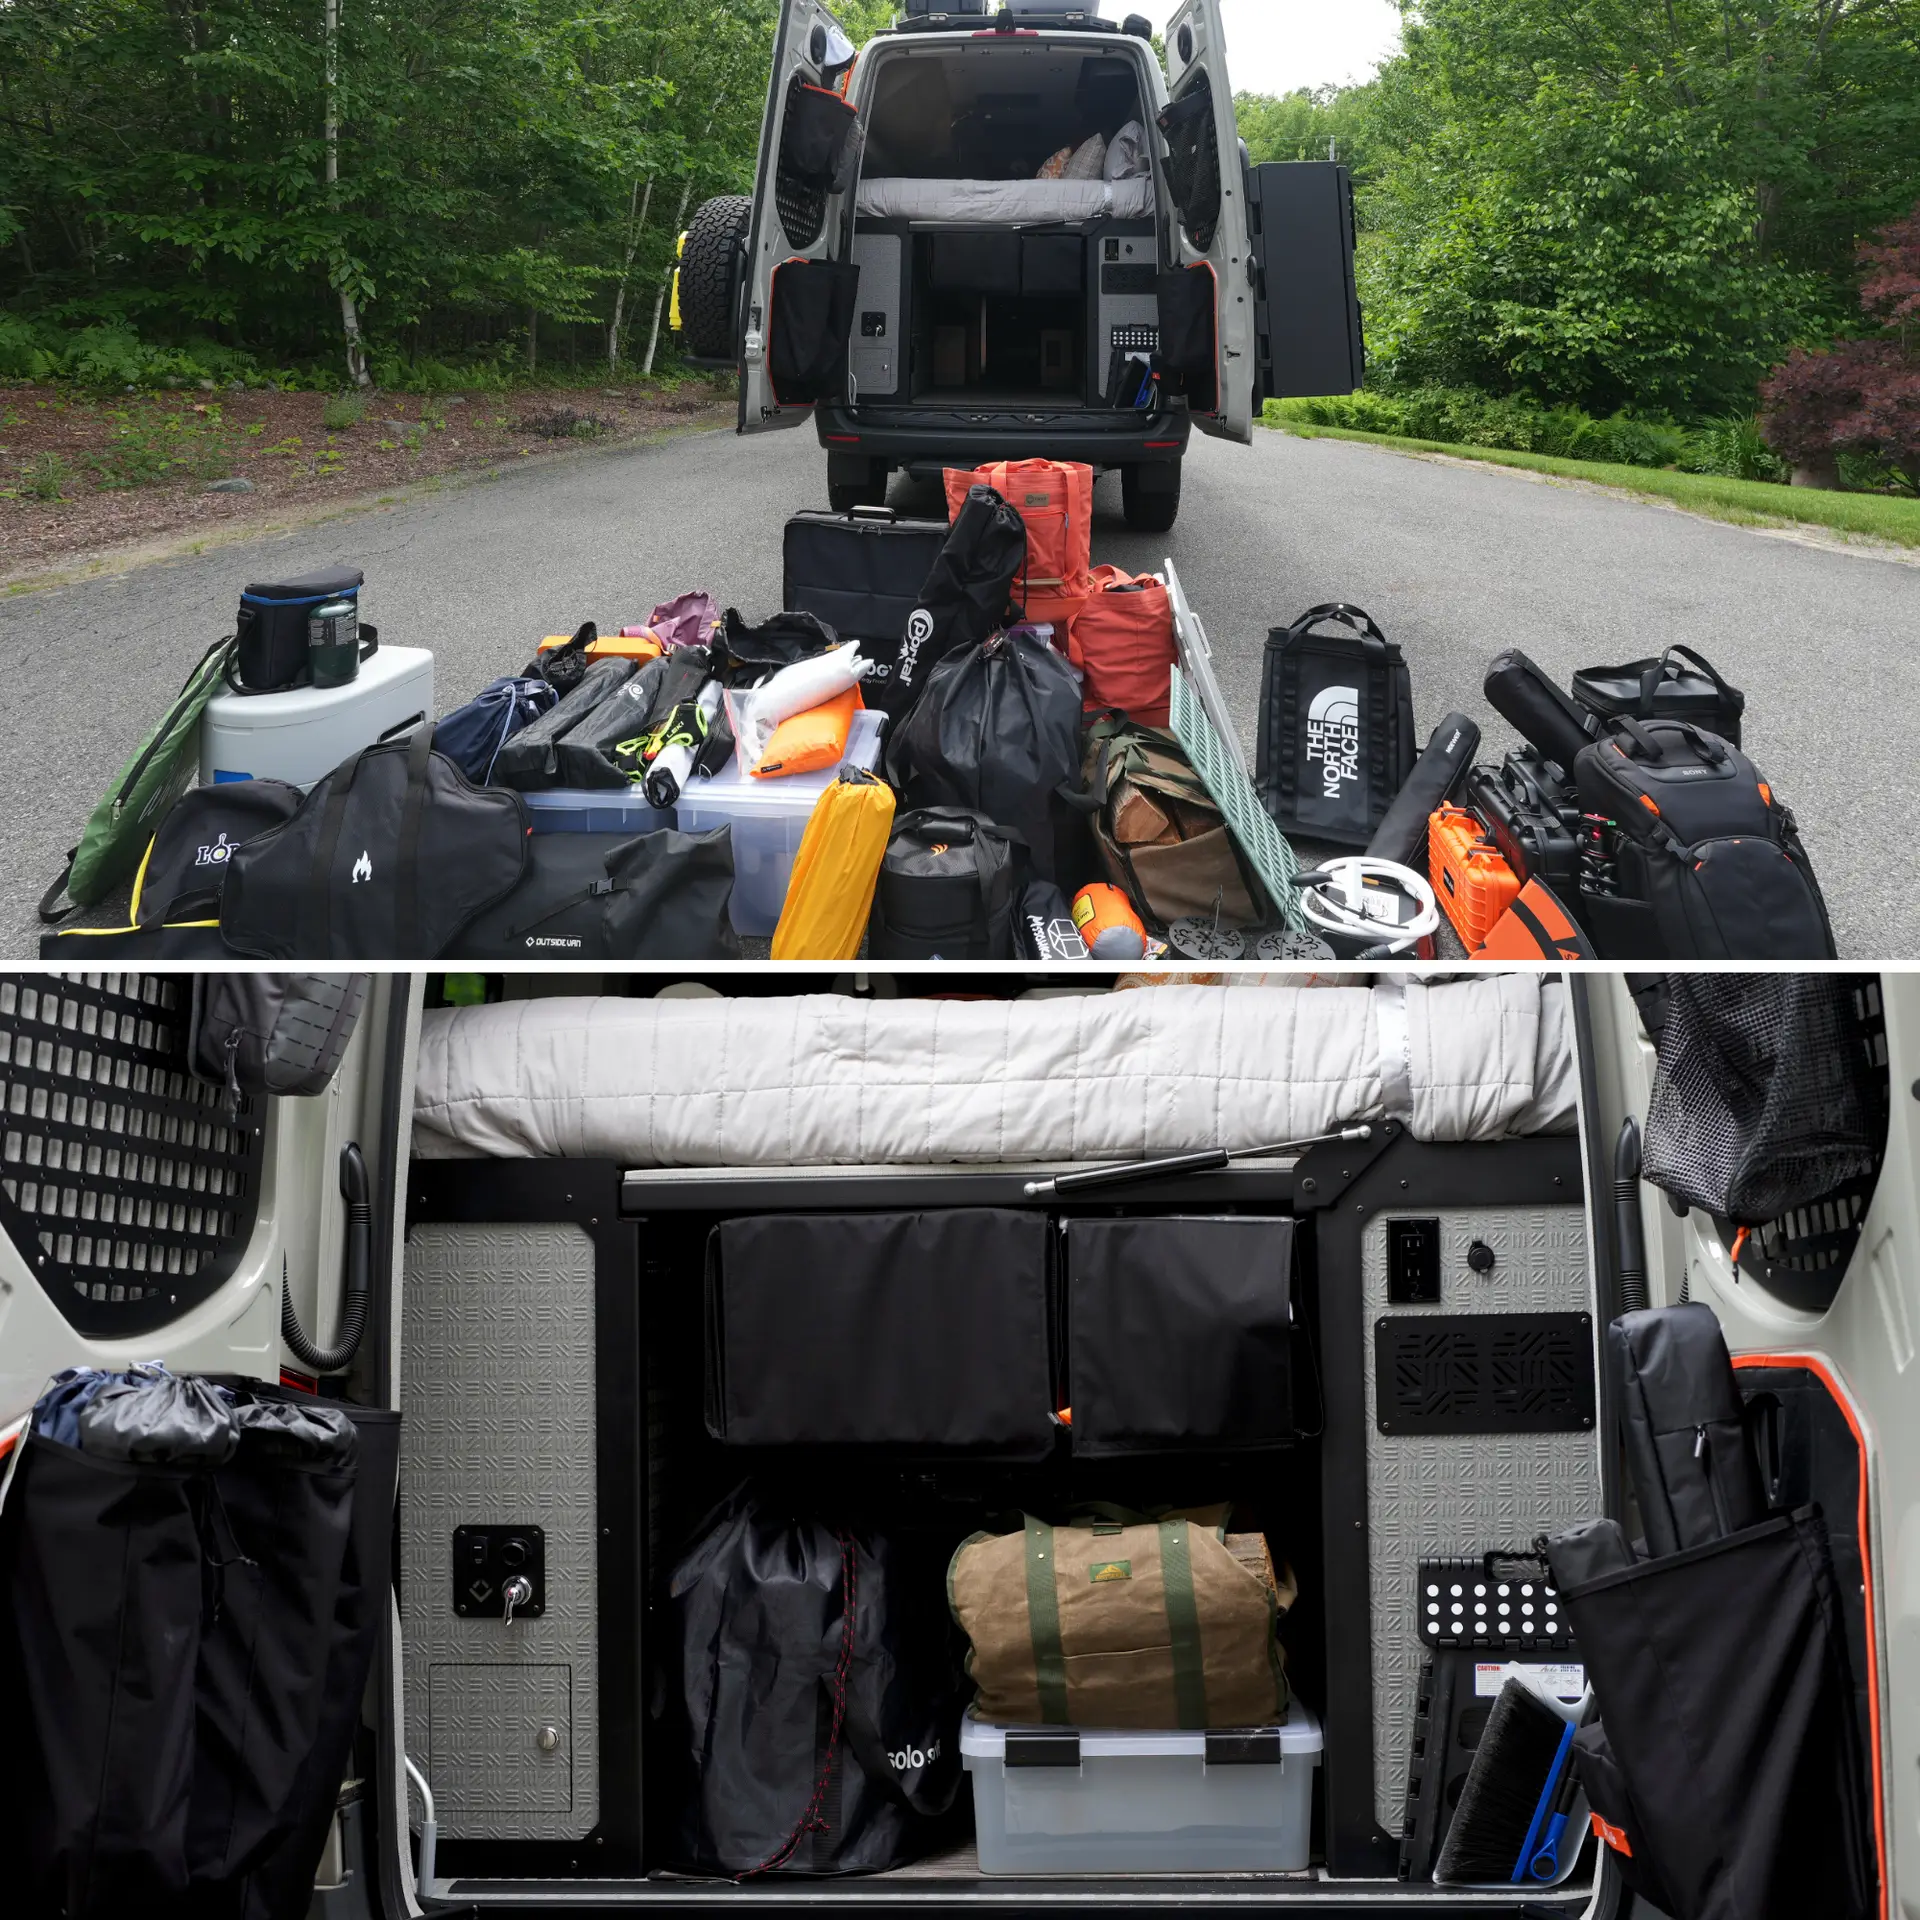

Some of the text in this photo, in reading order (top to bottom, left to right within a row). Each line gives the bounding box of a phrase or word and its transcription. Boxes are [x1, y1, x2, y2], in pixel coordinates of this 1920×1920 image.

[900, 620, 927, 683] Portal
[1306, 720, 1324, 761] THE
[1323, 723, 1341, 799] NORTH
[1340, 725, 1358, 781] FACE
